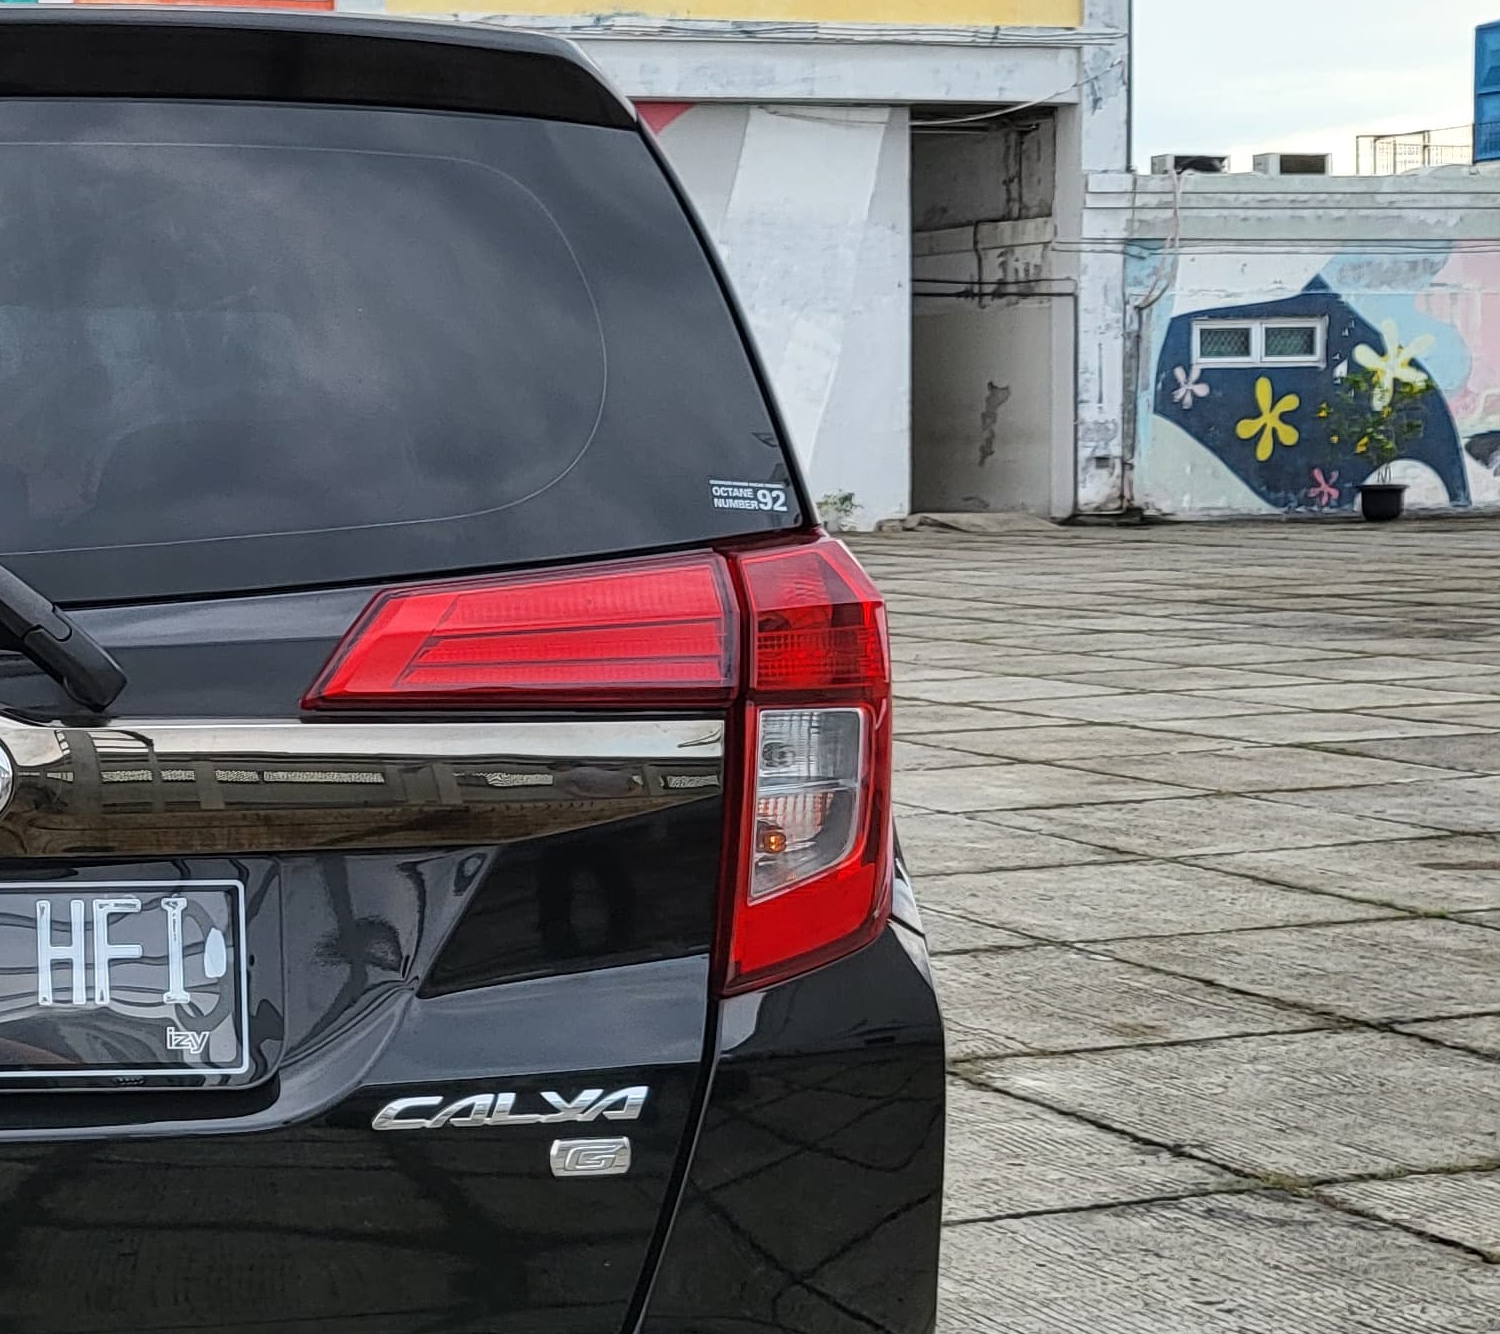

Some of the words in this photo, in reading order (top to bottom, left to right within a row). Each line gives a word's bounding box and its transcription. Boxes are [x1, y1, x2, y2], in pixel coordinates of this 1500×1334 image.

[711, 486, 754, 498] OCTANE
[713, 497, 759, 510] NUMBER
[757, 489, 788, 512] 92
[371, 1085, 650, 1131] CALYA
[564, 1144, 623, 1171] G
